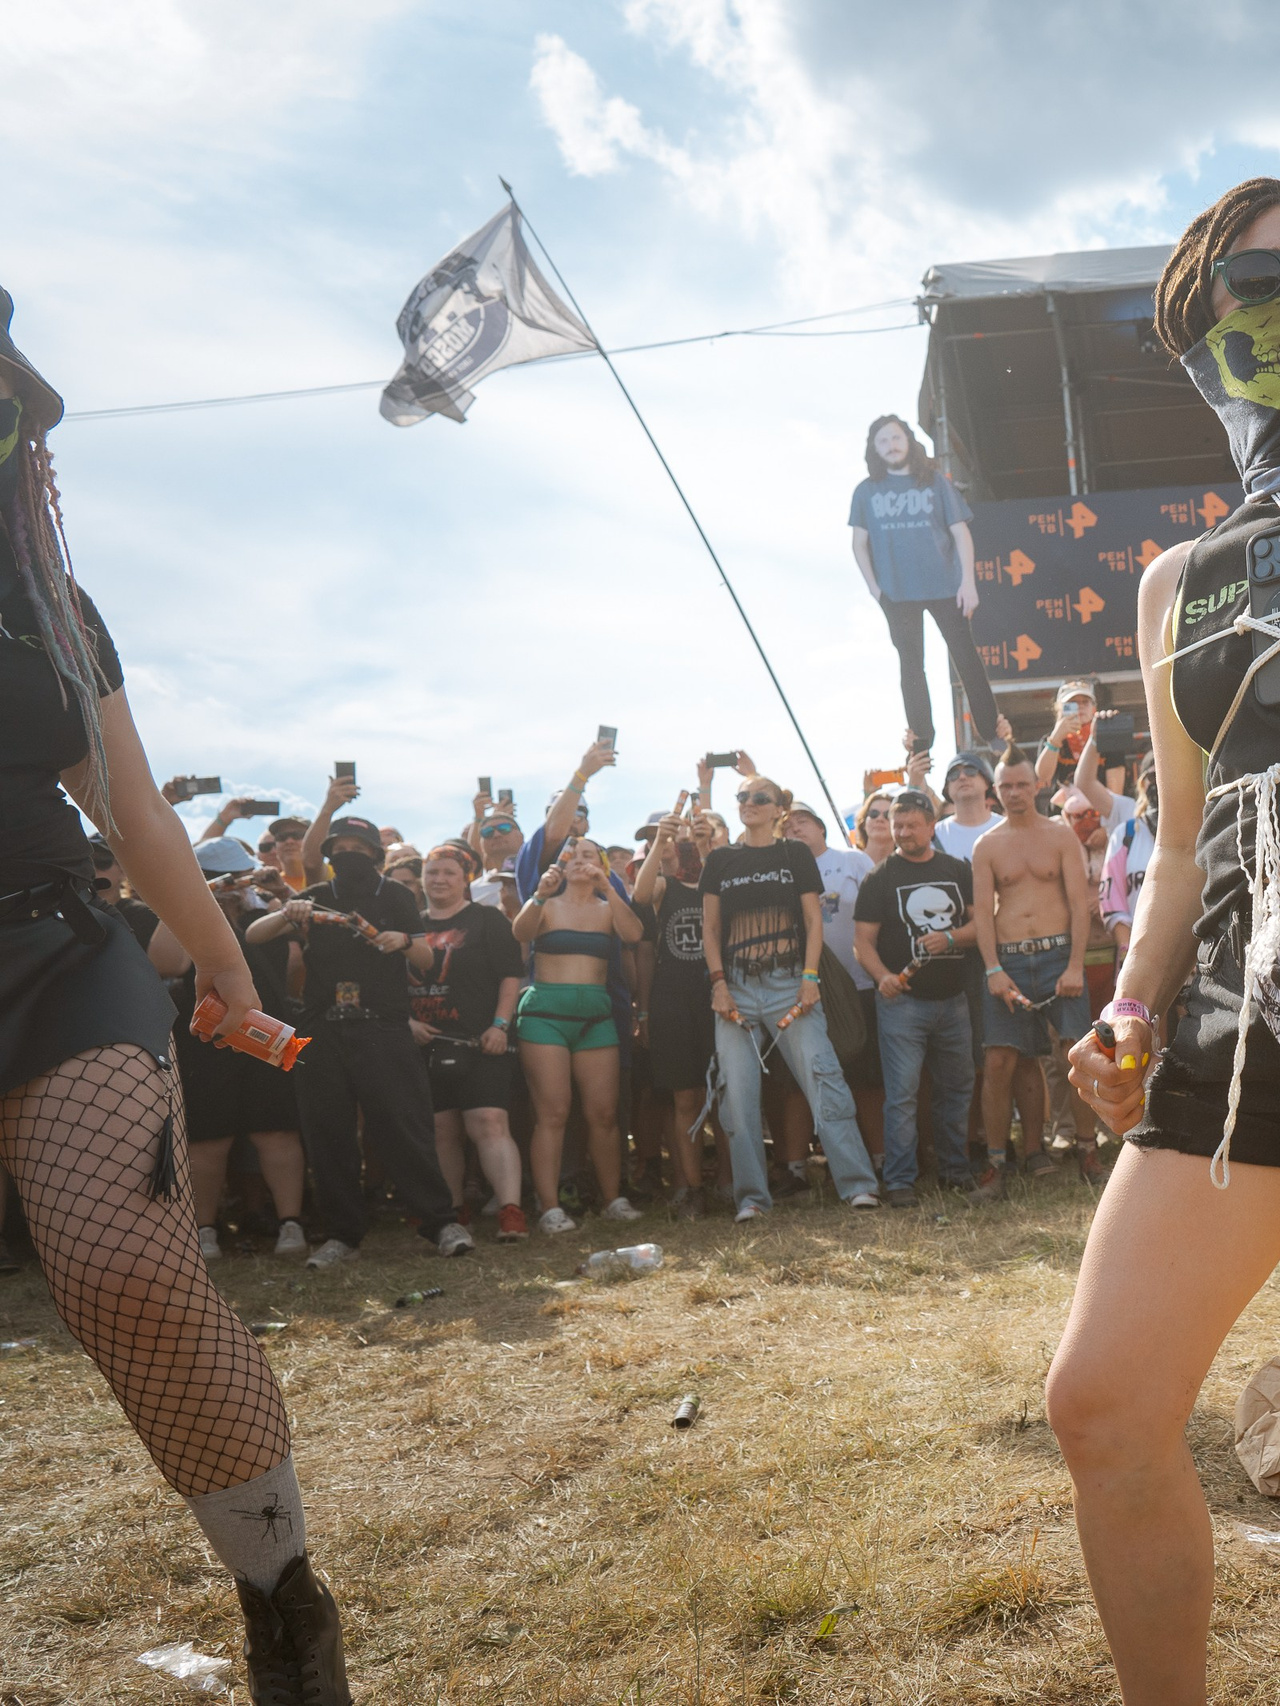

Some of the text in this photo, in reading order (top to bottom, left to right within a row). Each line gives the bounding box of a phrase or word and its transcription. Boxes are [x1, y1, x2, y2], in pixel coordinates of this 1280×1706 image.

[1160, 503, 1188, 515] РЕН
[1028, 513, 1056, 525] РЕН
[1171, 514, 1189, 524] ТВ
[1039, 524, 1057, 534] ТВ
[1097, 551, 1126, 563] РЕН
[975, 560, 994, 572] ЕН
[1108, 561, 1126, 572] ТВ
[977, 571, 995, 581] ТВ
[1036, 599, 1064, 610] РЕН
[1046, 609, 1064, 619] ТВ
[1105, 636, 1133, 648] РЕН
[1115, 646, 1133, 657] ТВ
[984, 655, 1000, 666] ТВ
